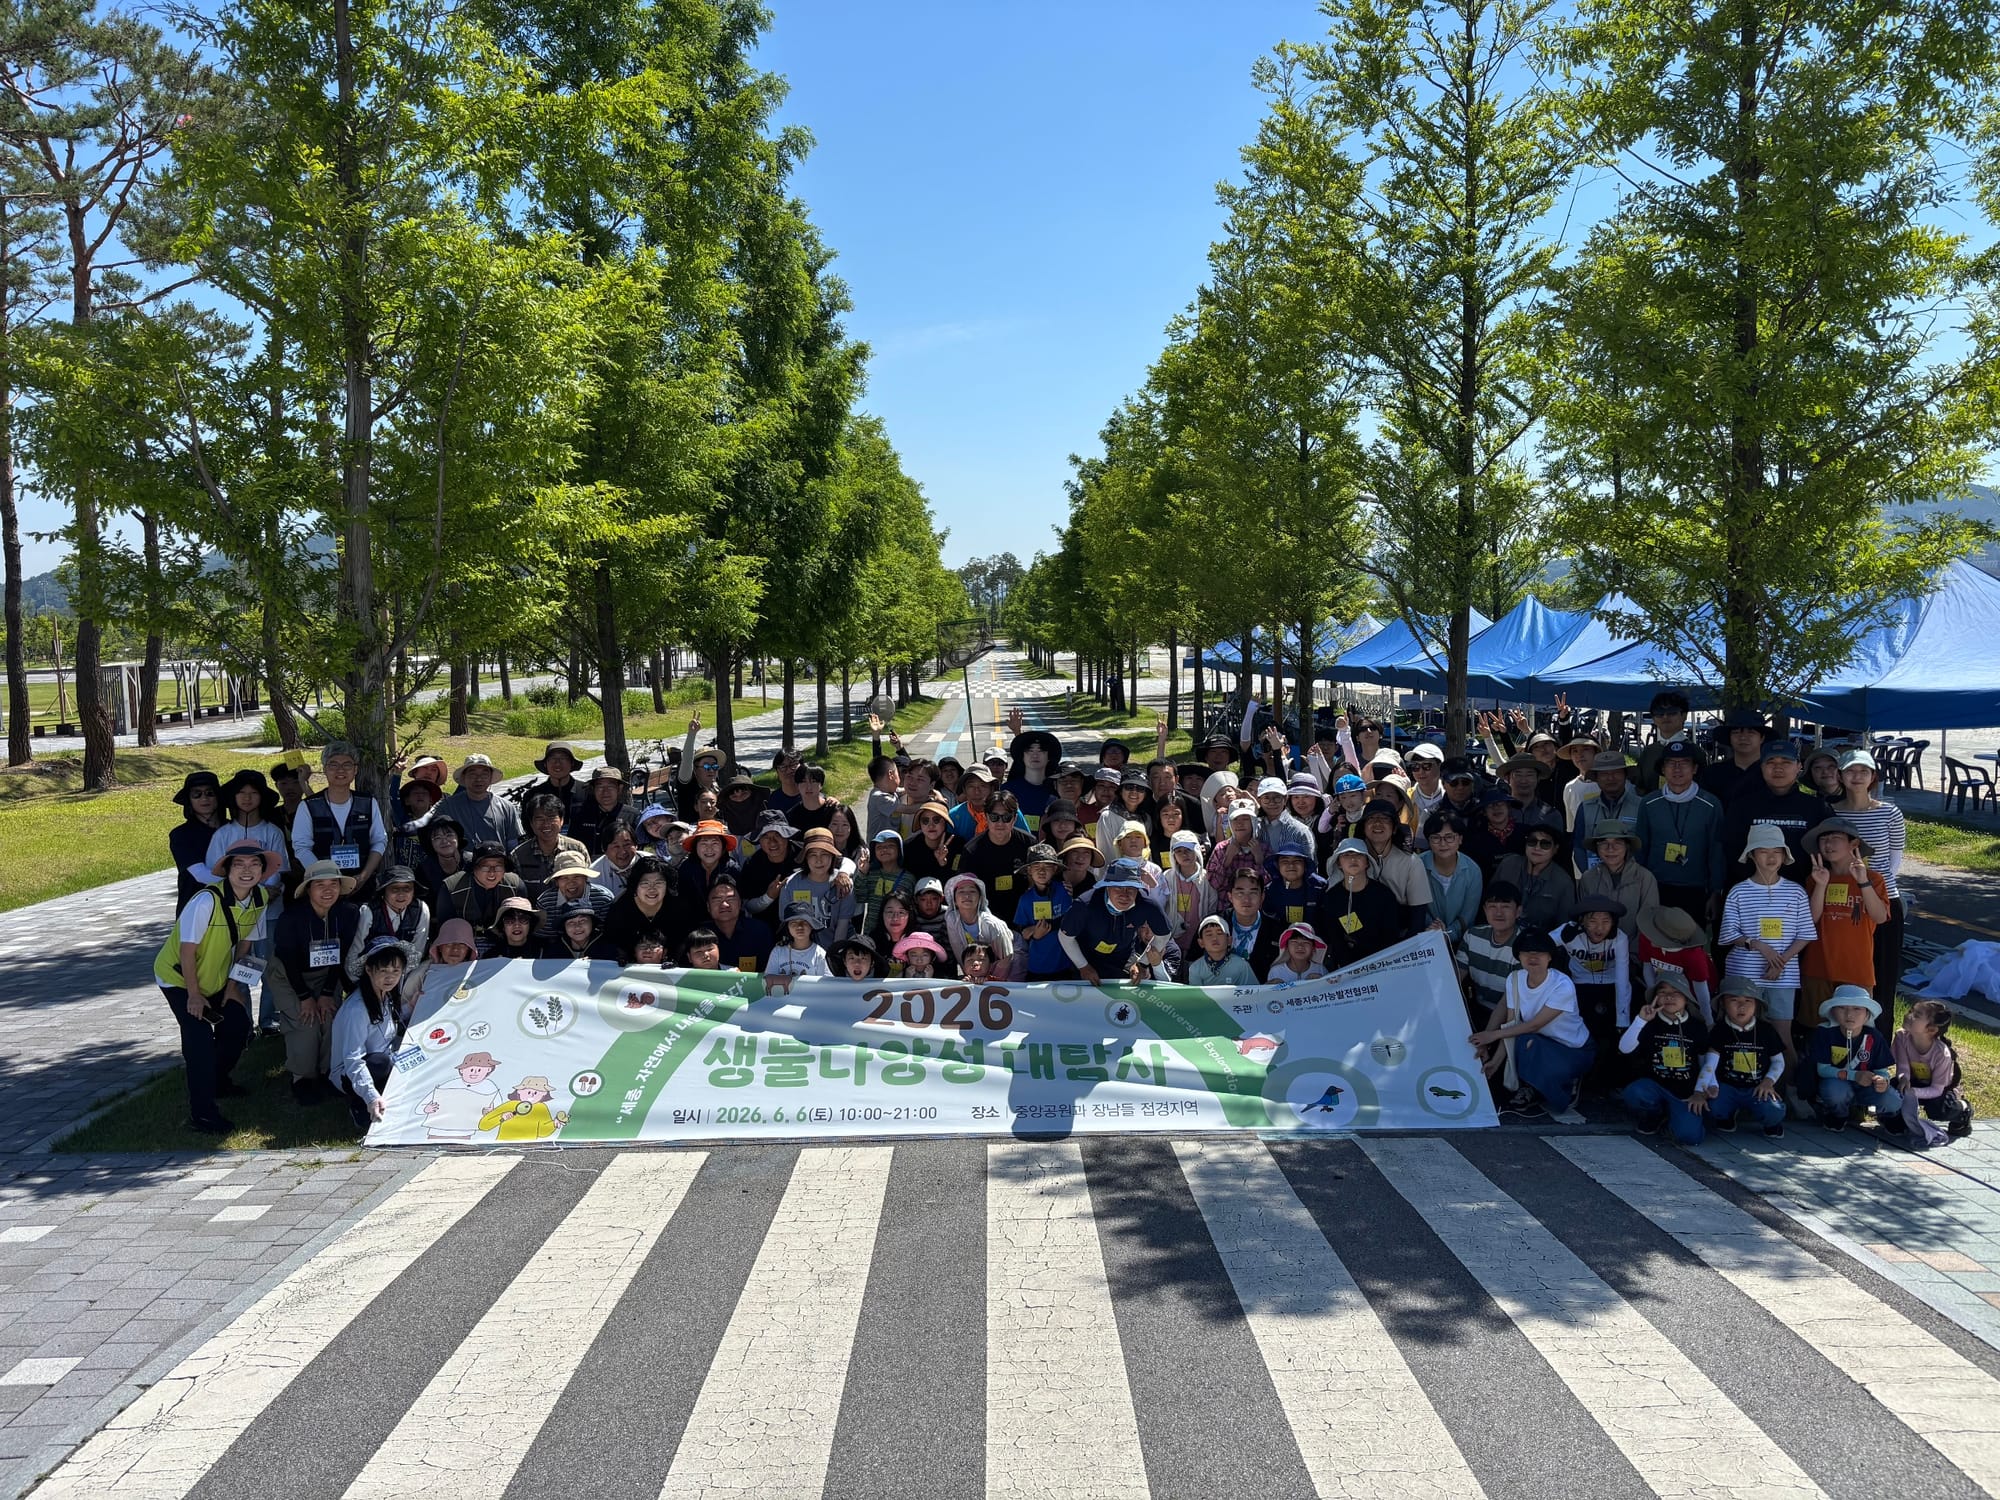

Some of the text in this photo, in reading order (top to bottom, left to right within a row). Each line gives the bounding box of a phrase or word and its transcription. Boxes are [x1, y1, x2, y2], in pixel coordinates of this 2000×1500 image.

[1752, 818, 1808, 827] HUMMER
[862, 985, 1013, 1031] 2026
[1232, 1004, 1252, 1014] 주관
[1286, 984, 1379, 1007] 세종지속가능발전협의회
[636, 1031, 680, 1082] 자연에서
[1147, 992, 1207, 1044] Biodiversity
[1203, 1042, 1238, 1091] Exploratio
[703, 1036, 1171, 1088] 생물다양성 대탐사
[672, 1108, 701, 1125] 일시
[715, 1106, 767, 1125] 2026.
[773, 1107, 790, 1124] 6.
[839, 1106, 938, 1121] 10:00~21:00
[971, 1099, 1199, 1120] 장소 중앙공원과 장남들 접경지역
